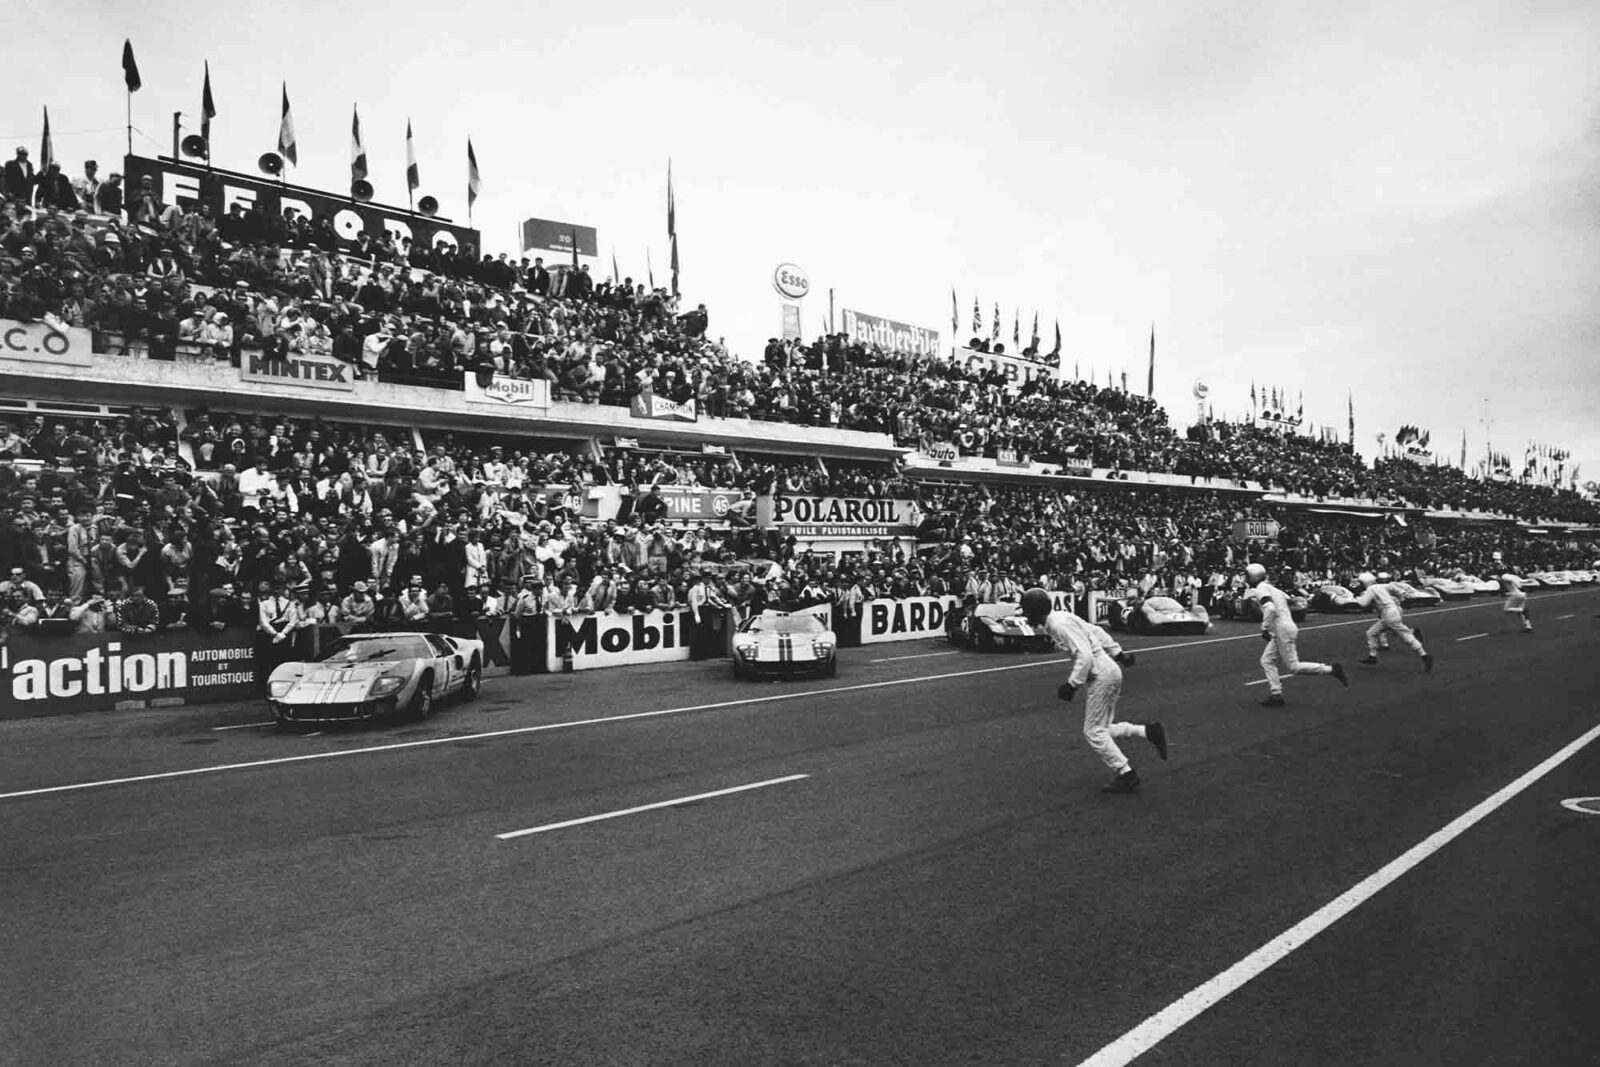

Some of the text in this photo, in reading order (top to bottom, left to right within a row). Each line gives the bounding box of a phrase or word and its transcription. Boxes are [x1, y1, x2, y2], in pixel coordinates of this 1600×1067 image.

[781, 270, 808, 289] Esso
[249, 355, 347, 383] MINTEX
[488, 381, 530, 394] Mobil
[773, 497, 900, 523] POLAROIL
[790, 527, 817, 535] HUILE
[555, 611, 692, 657] Mobil
[191, 648, 254, 662] AUTOMOBILE
[191, 672, 254, 687] TOURISTIQUE
